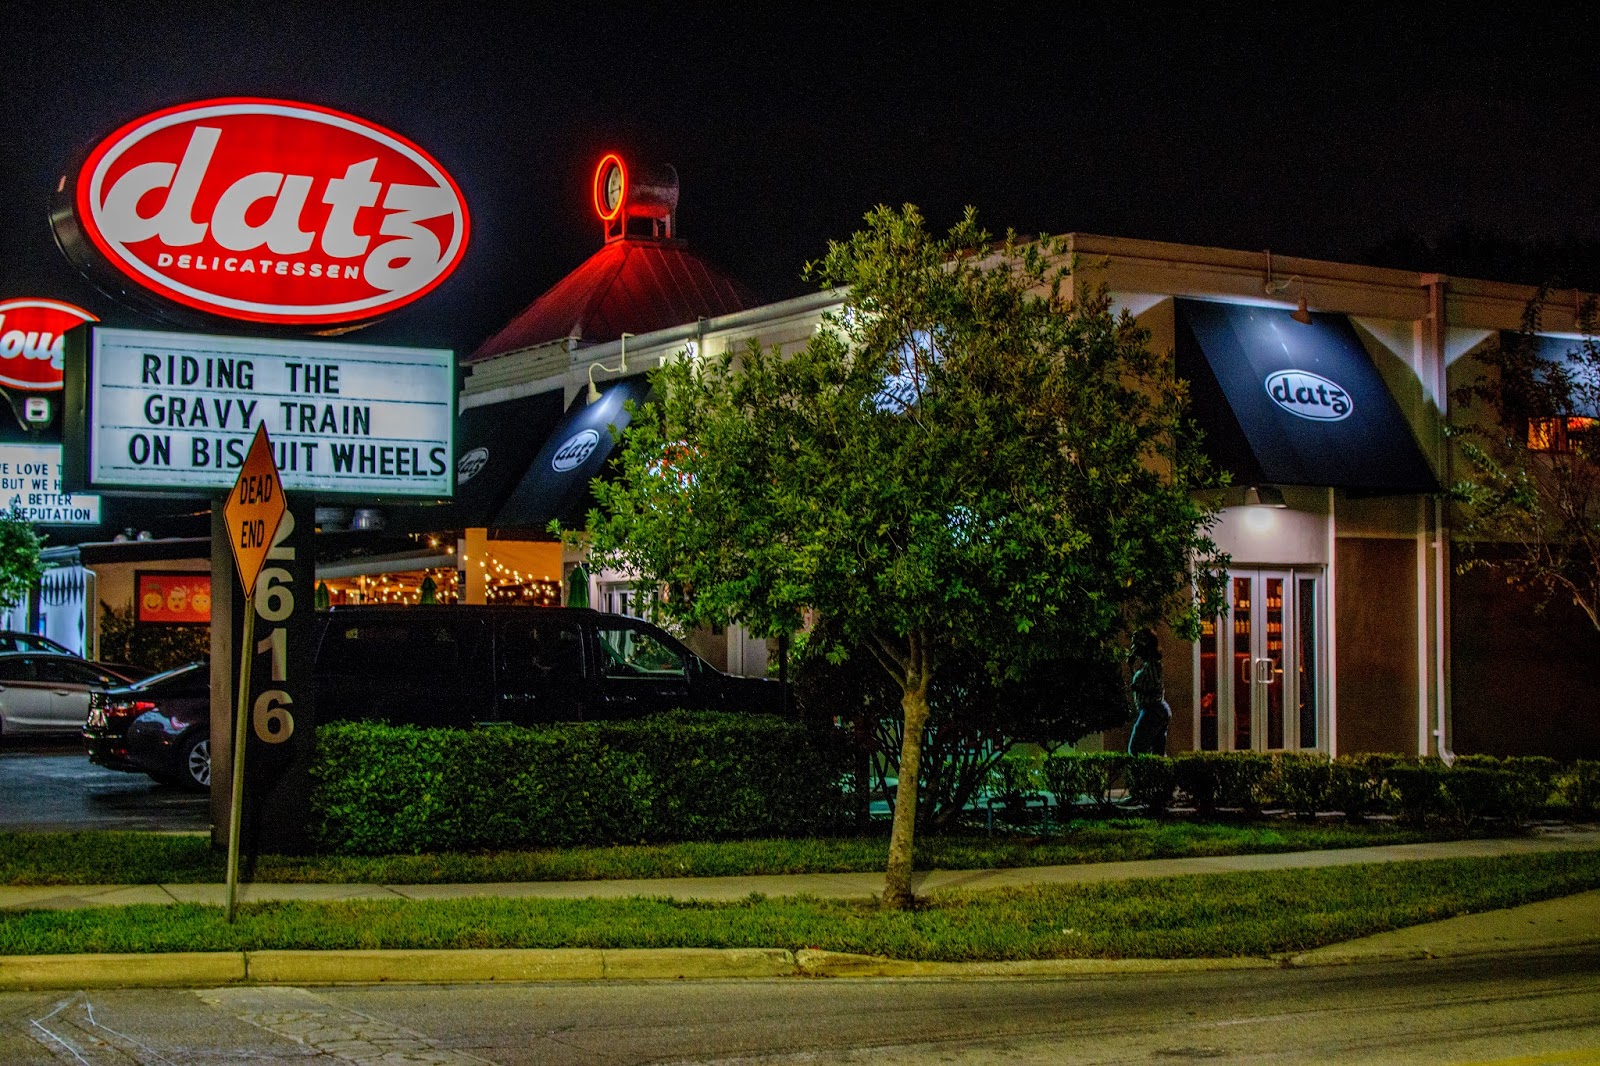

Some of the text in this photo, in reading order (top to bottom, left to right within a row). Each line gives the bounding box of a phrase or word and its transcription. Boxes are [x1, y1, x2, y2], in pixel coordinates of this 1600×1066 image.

[100, 126, 454, 292] datz
[157, 252, 360, 280] DELICATESSEN
[142, 353, 340, 394] RIDING THE
[1272, 377, 1348, 415] datz
[144, 394, 371, 436] GRAVY TRAIN
[0, 463, 9, 474] E
[16, 463, 49, 475] LOVE
[128, 434, 447, 477] ON BISUIT WHEELS
[2, 478, 25, 490] BUT
[32, 479, 48, 491] WE
[13, 493, 72, 506] A BETTER
[239, 474, 273, 505] DEAD
[241, 519, 265, 549] END
